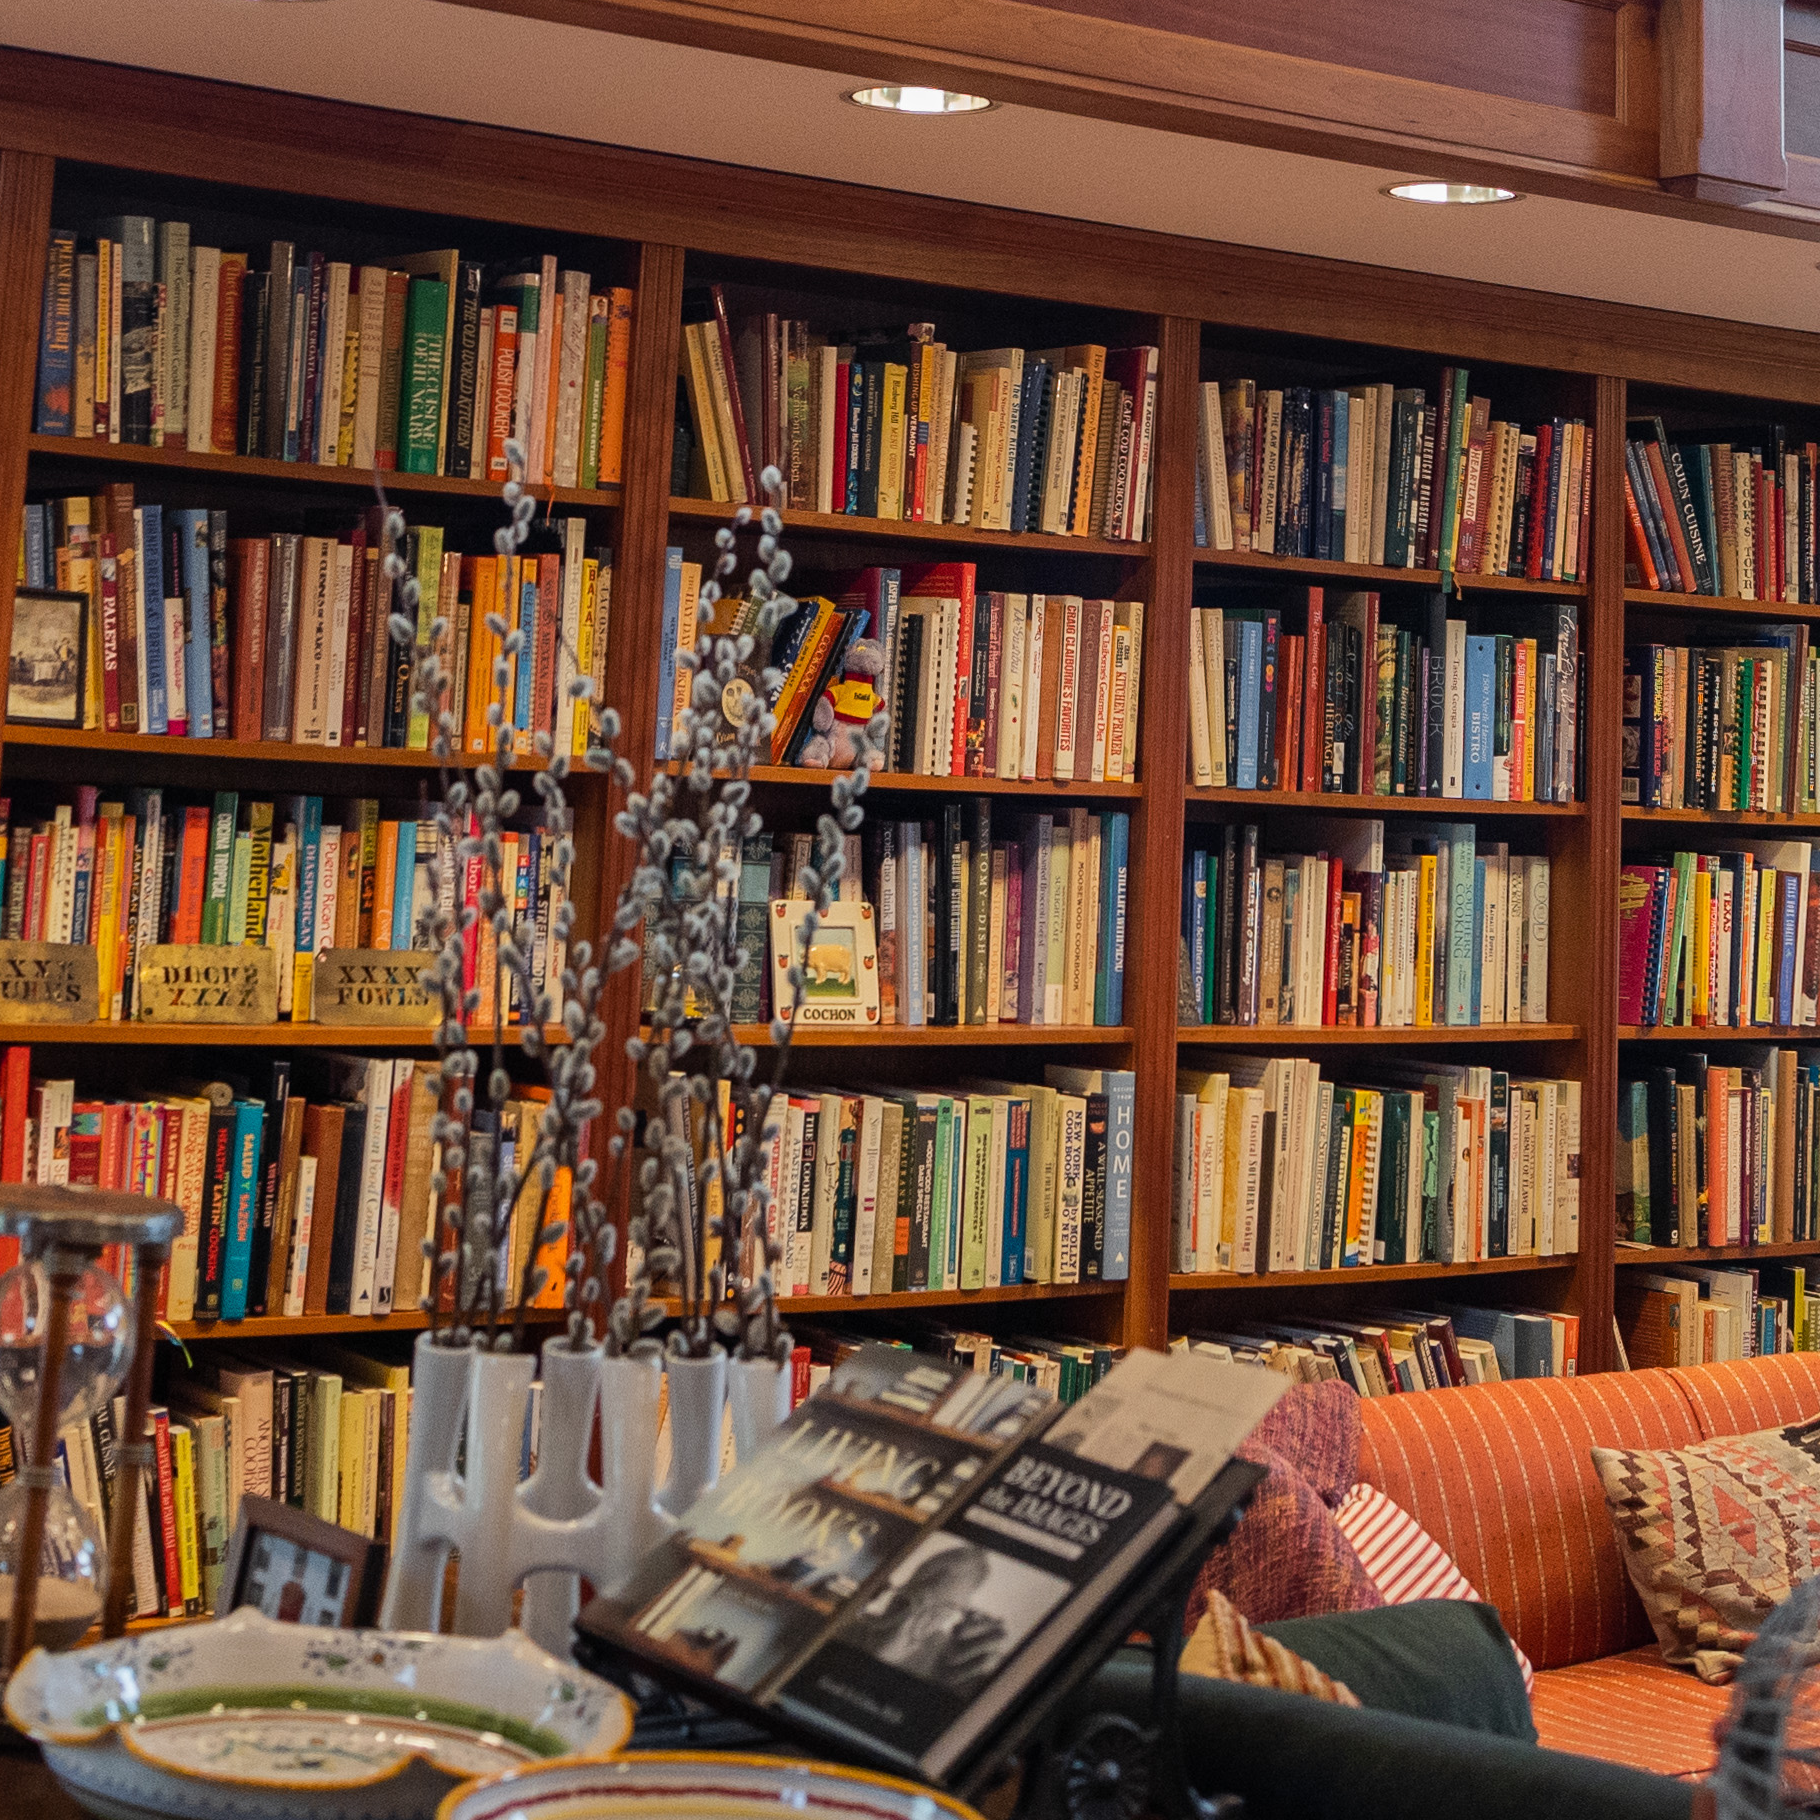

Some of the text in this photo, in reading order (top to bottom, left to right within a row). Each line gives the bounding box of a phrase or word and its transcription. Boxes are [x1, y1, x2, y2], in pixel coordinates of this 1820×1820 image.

[310, 273, 321, 309] TASTE
[305, 329, 318, 379] CROATIA
[409, 338, 428, 441] OF HUNGARY
[423, 340, 442, 443] THE CUISINE
[493, 348, 514, 439] POLISH COOKERY
[1141, 390, 1154, 465] IT'S ABOUT TIME
[1464, 449, 1481, 520] HEARTLAND
[1671, 452, 1707, 565] CAJUN CUISINE
[103, 596, 117, 671] PALETAS
[585, 569, 597, 624] BAJA
[1110, 670, 1128, 756] KITCHEN PRIMER
[1450, 659, 1462, 728] Tasting Georgia
[1323, 701, 1335, 767] HERITAGE
[1470, 710, 1482, 763] BISTRO
[211, 812, 233, 899] COCINA TROPICAL
[245, 826, 270, 939] Motherland
[299, 844, 317, 946] DIASPORICAN
[1072, 861, 1085, 992] MOOSEWOOD COOKBOOK
[1453, 883, 1464, 959] COOKING
[1463, 883, 1474, 960] SOUTHERN
[1723, 892, 1732, 933] TEXAS
[338, 965, 422, 985] XXXX
[338, 987, 430, 1008] FOWLS
[802, 1008, 857, 1021] COCHON
[205, 1128, 229, 1282] HEALTHY LATIN COOKING
[785, 1418, 942, 1505] LIVING
[980, 1484, 1018, 1511] the
[1003, 1456, 1134, 1522] BEYOND
